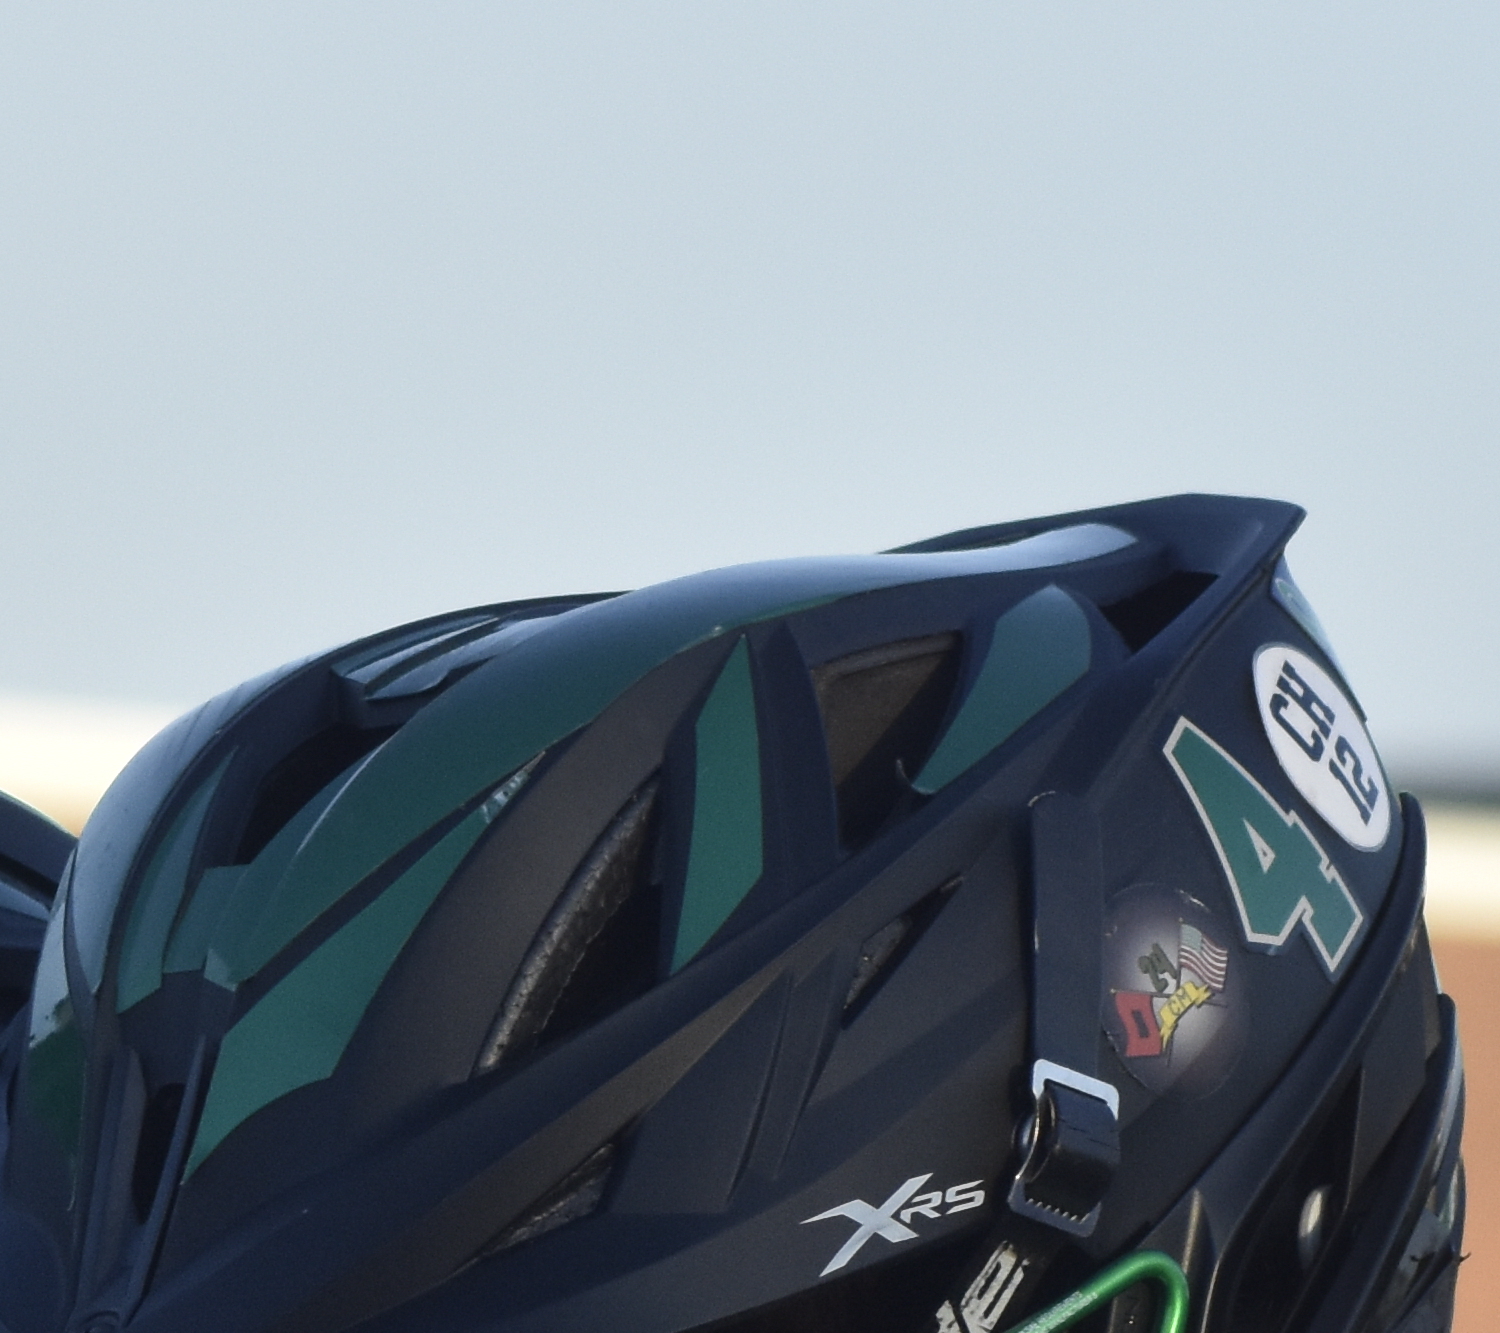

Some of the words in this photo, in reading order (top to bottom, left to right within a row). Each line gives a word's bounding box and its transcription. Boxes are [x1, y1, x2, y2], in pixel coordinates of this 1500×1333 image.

[1269, 659, 1336, 763] CH
[1327, 734, 1379, 827] 12
[1162, 716, 1364, 974] 4
